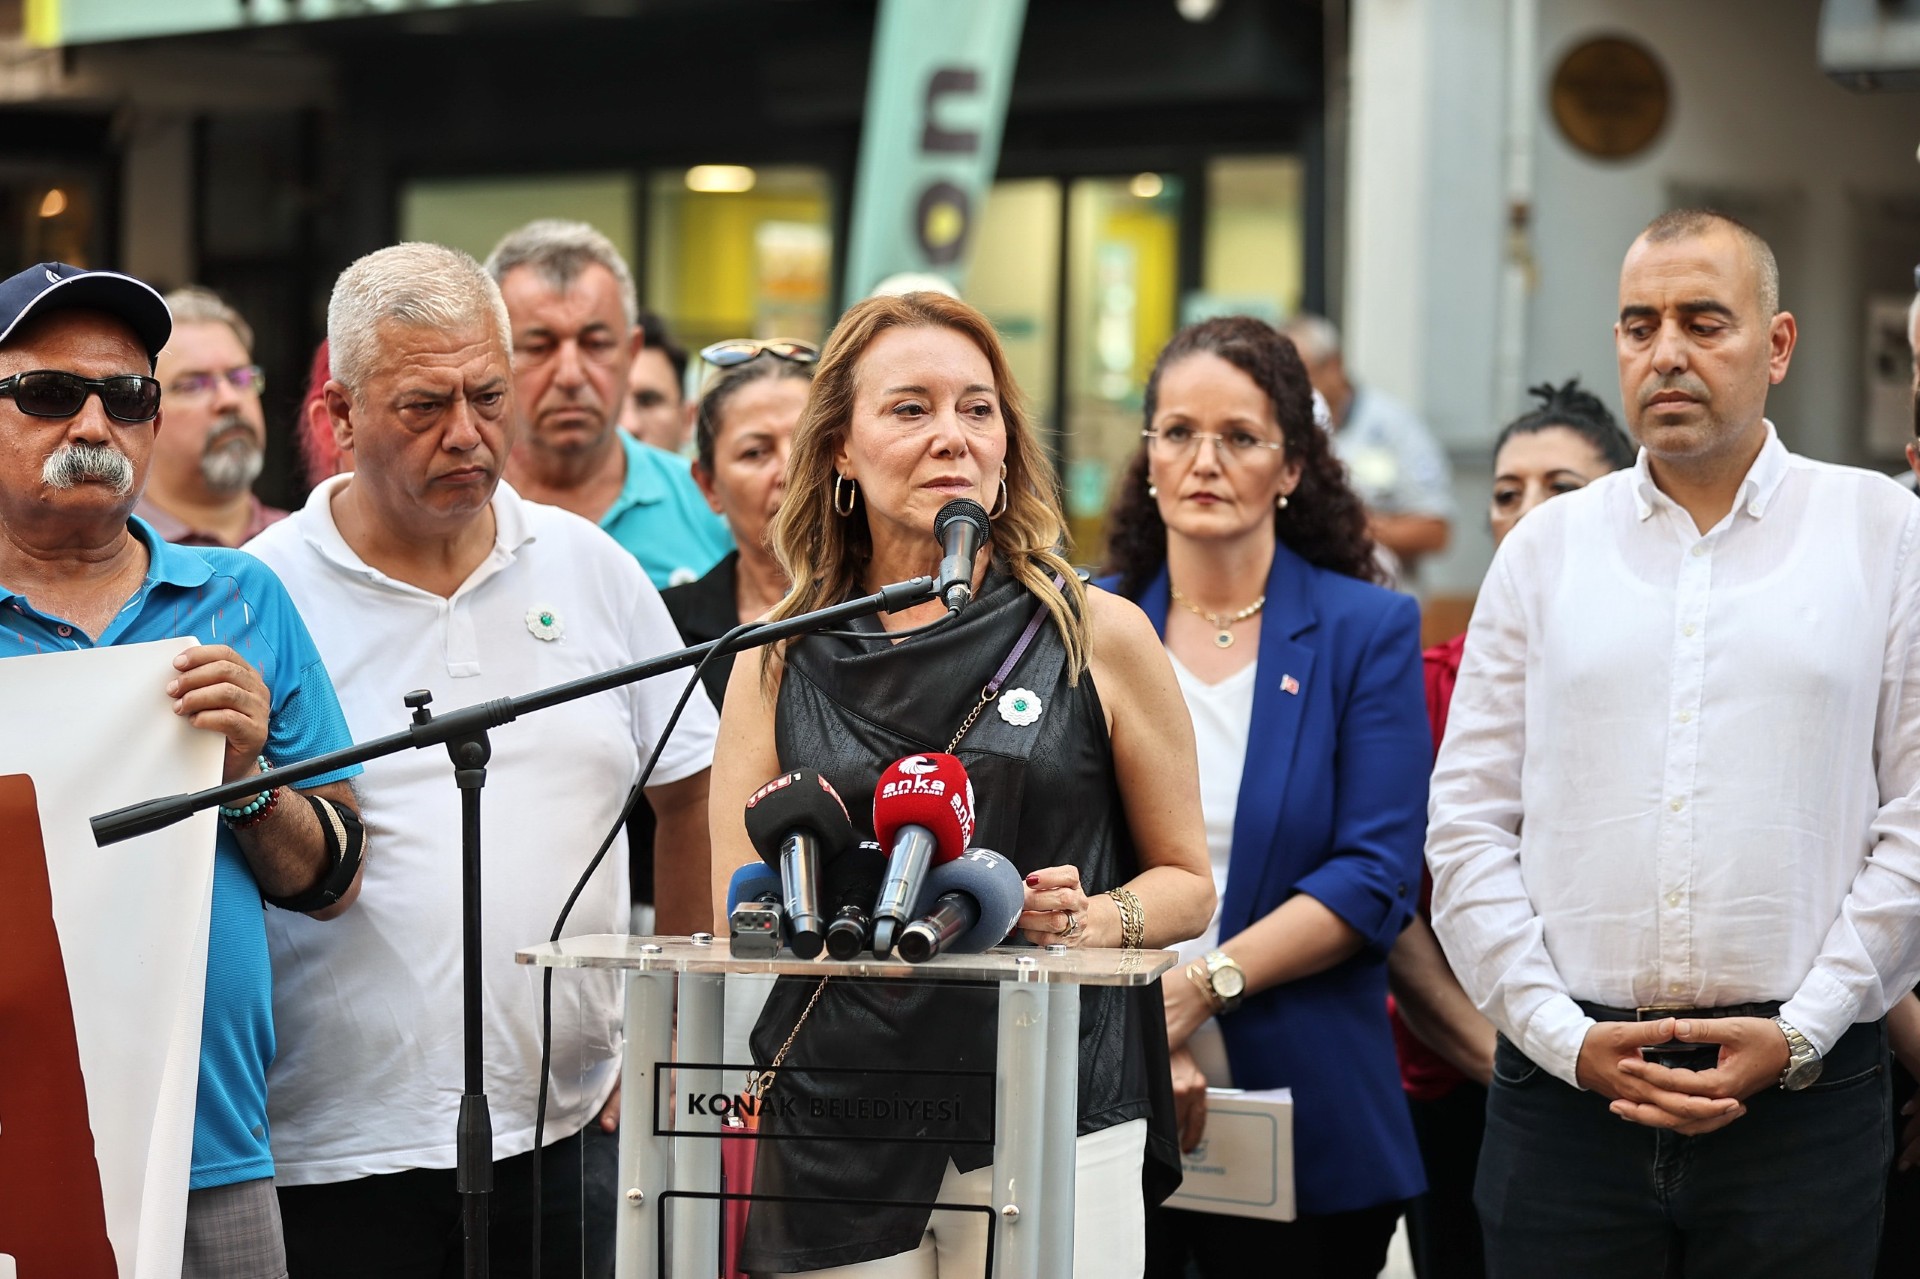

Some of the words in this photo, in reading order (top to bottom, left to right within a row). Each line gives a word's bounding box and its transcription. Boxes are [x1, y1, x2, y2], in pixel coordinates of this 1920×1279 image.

[883, 775, 945, 794] anka
[688, 1093, 796, 1117] KONAK
[810, 1092, 961, 1121] BELEDİYESİ
